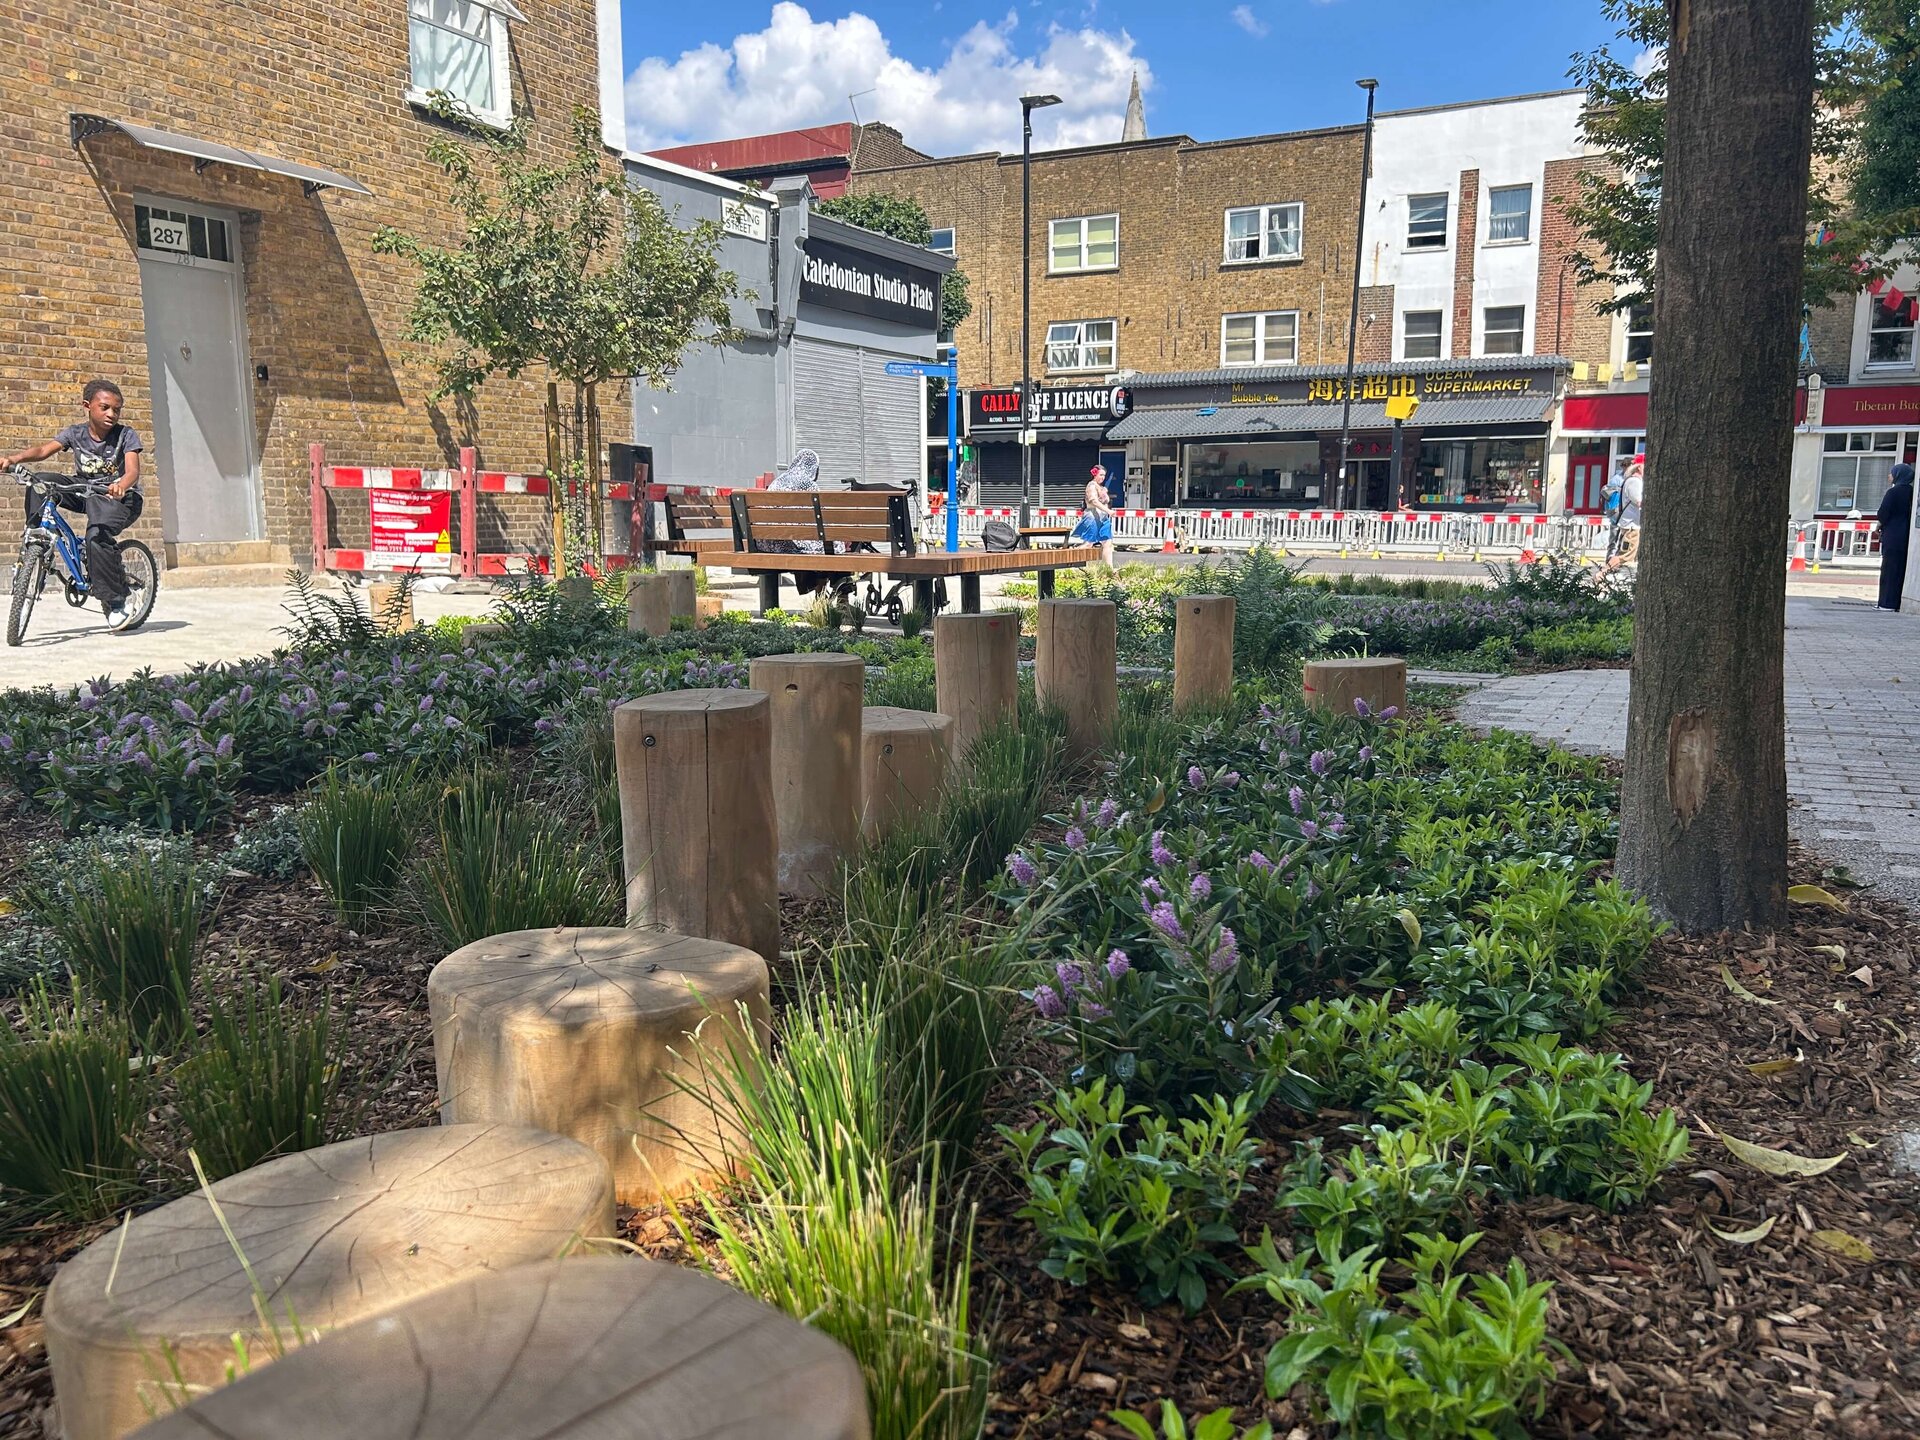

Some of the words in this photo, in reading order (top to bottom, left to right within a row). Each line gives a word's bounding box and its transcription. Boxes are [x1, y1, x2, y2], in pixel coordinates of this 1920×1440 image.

[725, 219, 752, 234] STREET
[153, 226, 183, 245] 287
[803, 254, 871, 296] Caledonian
[873, 273, 908, 305] Studio
[910, 283, 934, 311] Flats
[1425, 370, 1474, 380] OCEAN
[1232, 384, 1245, 392] Mr
[1424, 378, 1532, 394] SUPERMARKET
[981, 392, 1021, 412] CALLY
[1053, 390, 1109, 411] LICENCE
[1231, 394, 1261, 403] Bubble
[1265, 393, 1279, 403] Tea
[1853, 400, 1895, 411] Tibetan
